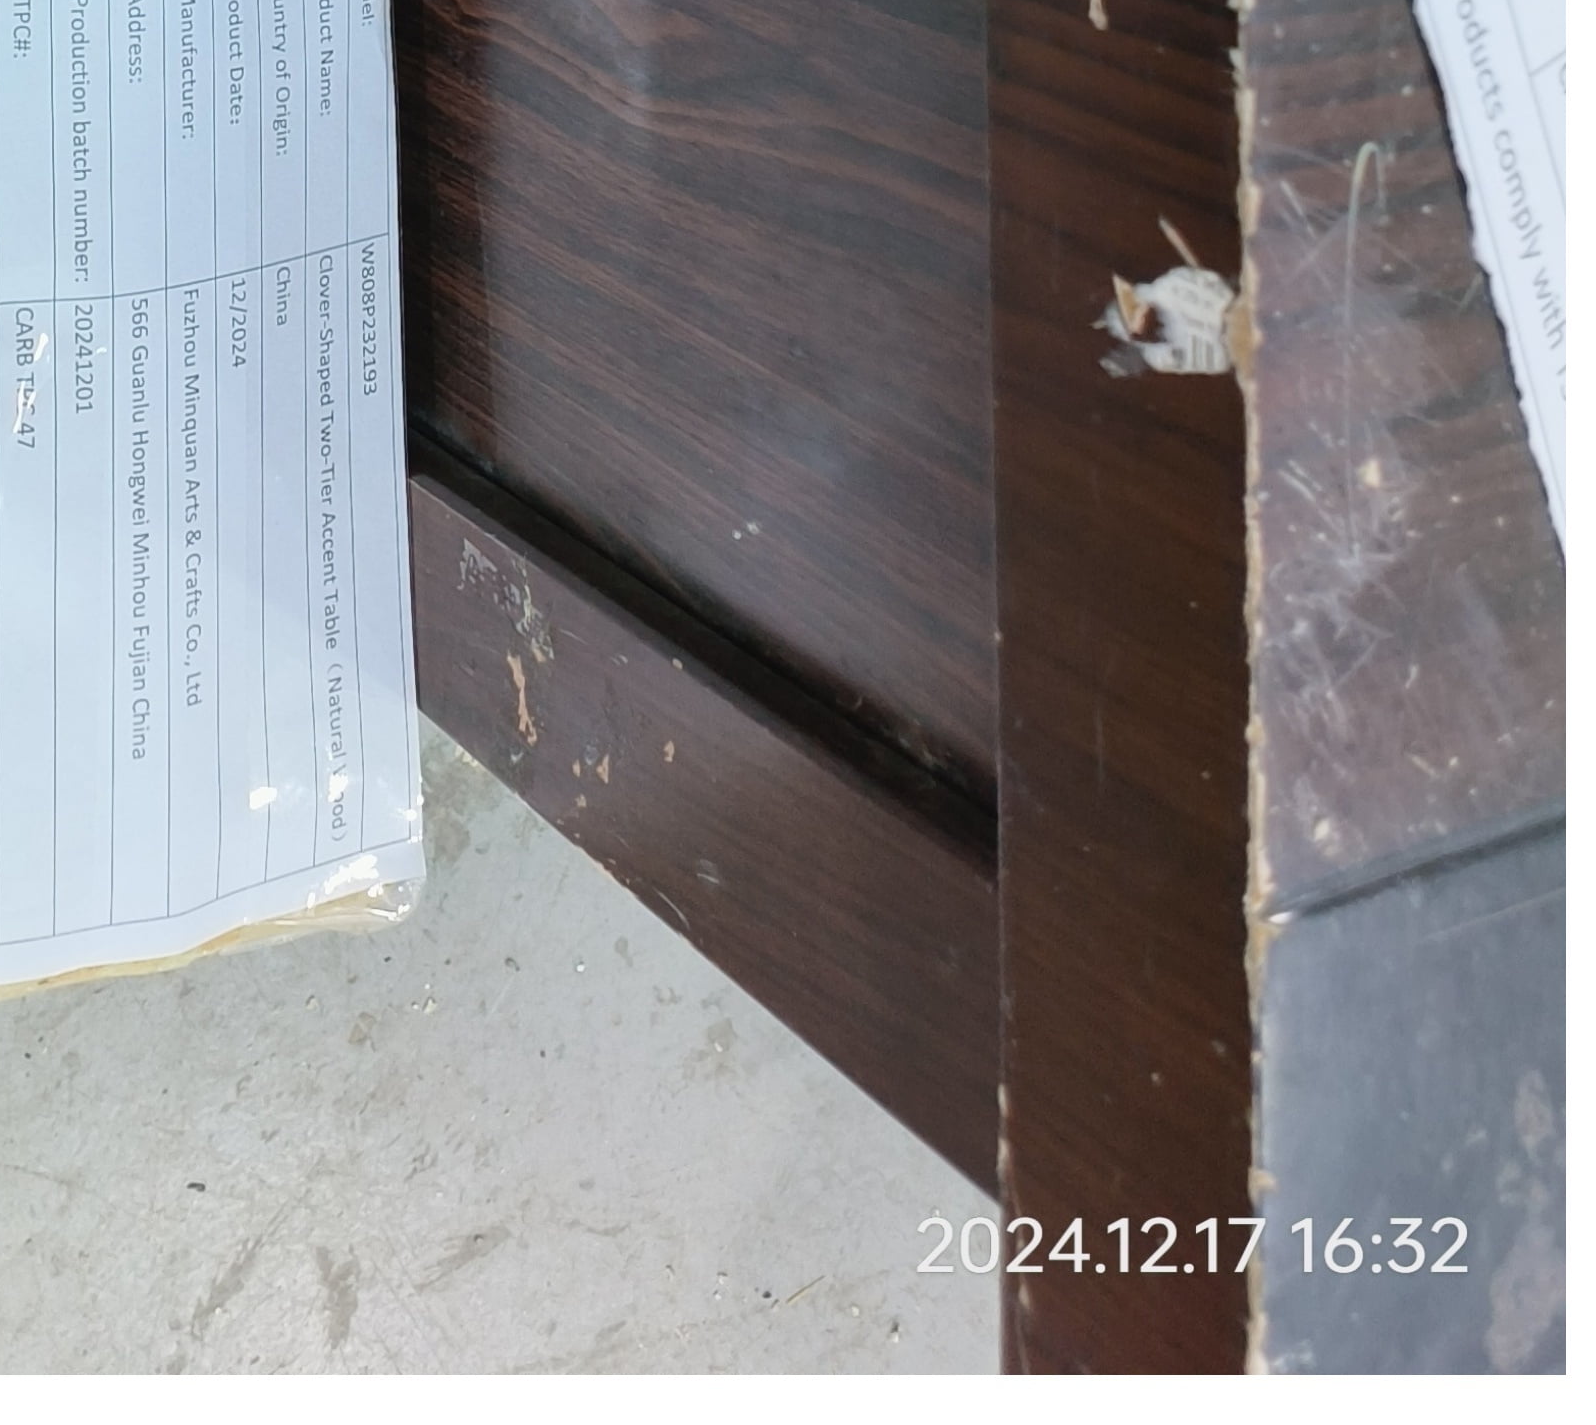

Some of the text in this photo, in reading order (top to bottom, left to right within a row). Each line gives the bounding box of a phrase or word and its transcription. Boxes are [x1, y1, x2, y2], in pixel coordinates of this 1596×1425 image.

[229, 67, 245, 125] Date:
[274, 59, 291, 81] of
[318, 49, 335, 117] Name:
[73, 121, 91, 181] batch
[272, 86, 292, 157] Origin:
[74, 189, 92, 283] number:
[1493, 130, 1545, 261] comply
[1531, 266, 1566, 351] with
[228, 278, 247, 368] 12/2024
[275, 266, 292, 326] China
[316, 254, 335, 406] Clover-Shaped
[360, 243, 378, 396] W808P232193
[16, 307, 35, 366] CARB
[75, 304, 94, 414] 20241201
[16, 423, 36, 449] 47
[319, 411, 337, 505] Two-Tier
[129, 298, 150, 759] 566 Guanlu Hongwei Minhou Fujian China
[181, 289, 203, 707] Fuzhou Minquan Arts & Crafts Co., Ltd
[321, 512, 338, 584] Accent
[323, 589, 341, 649] Table
